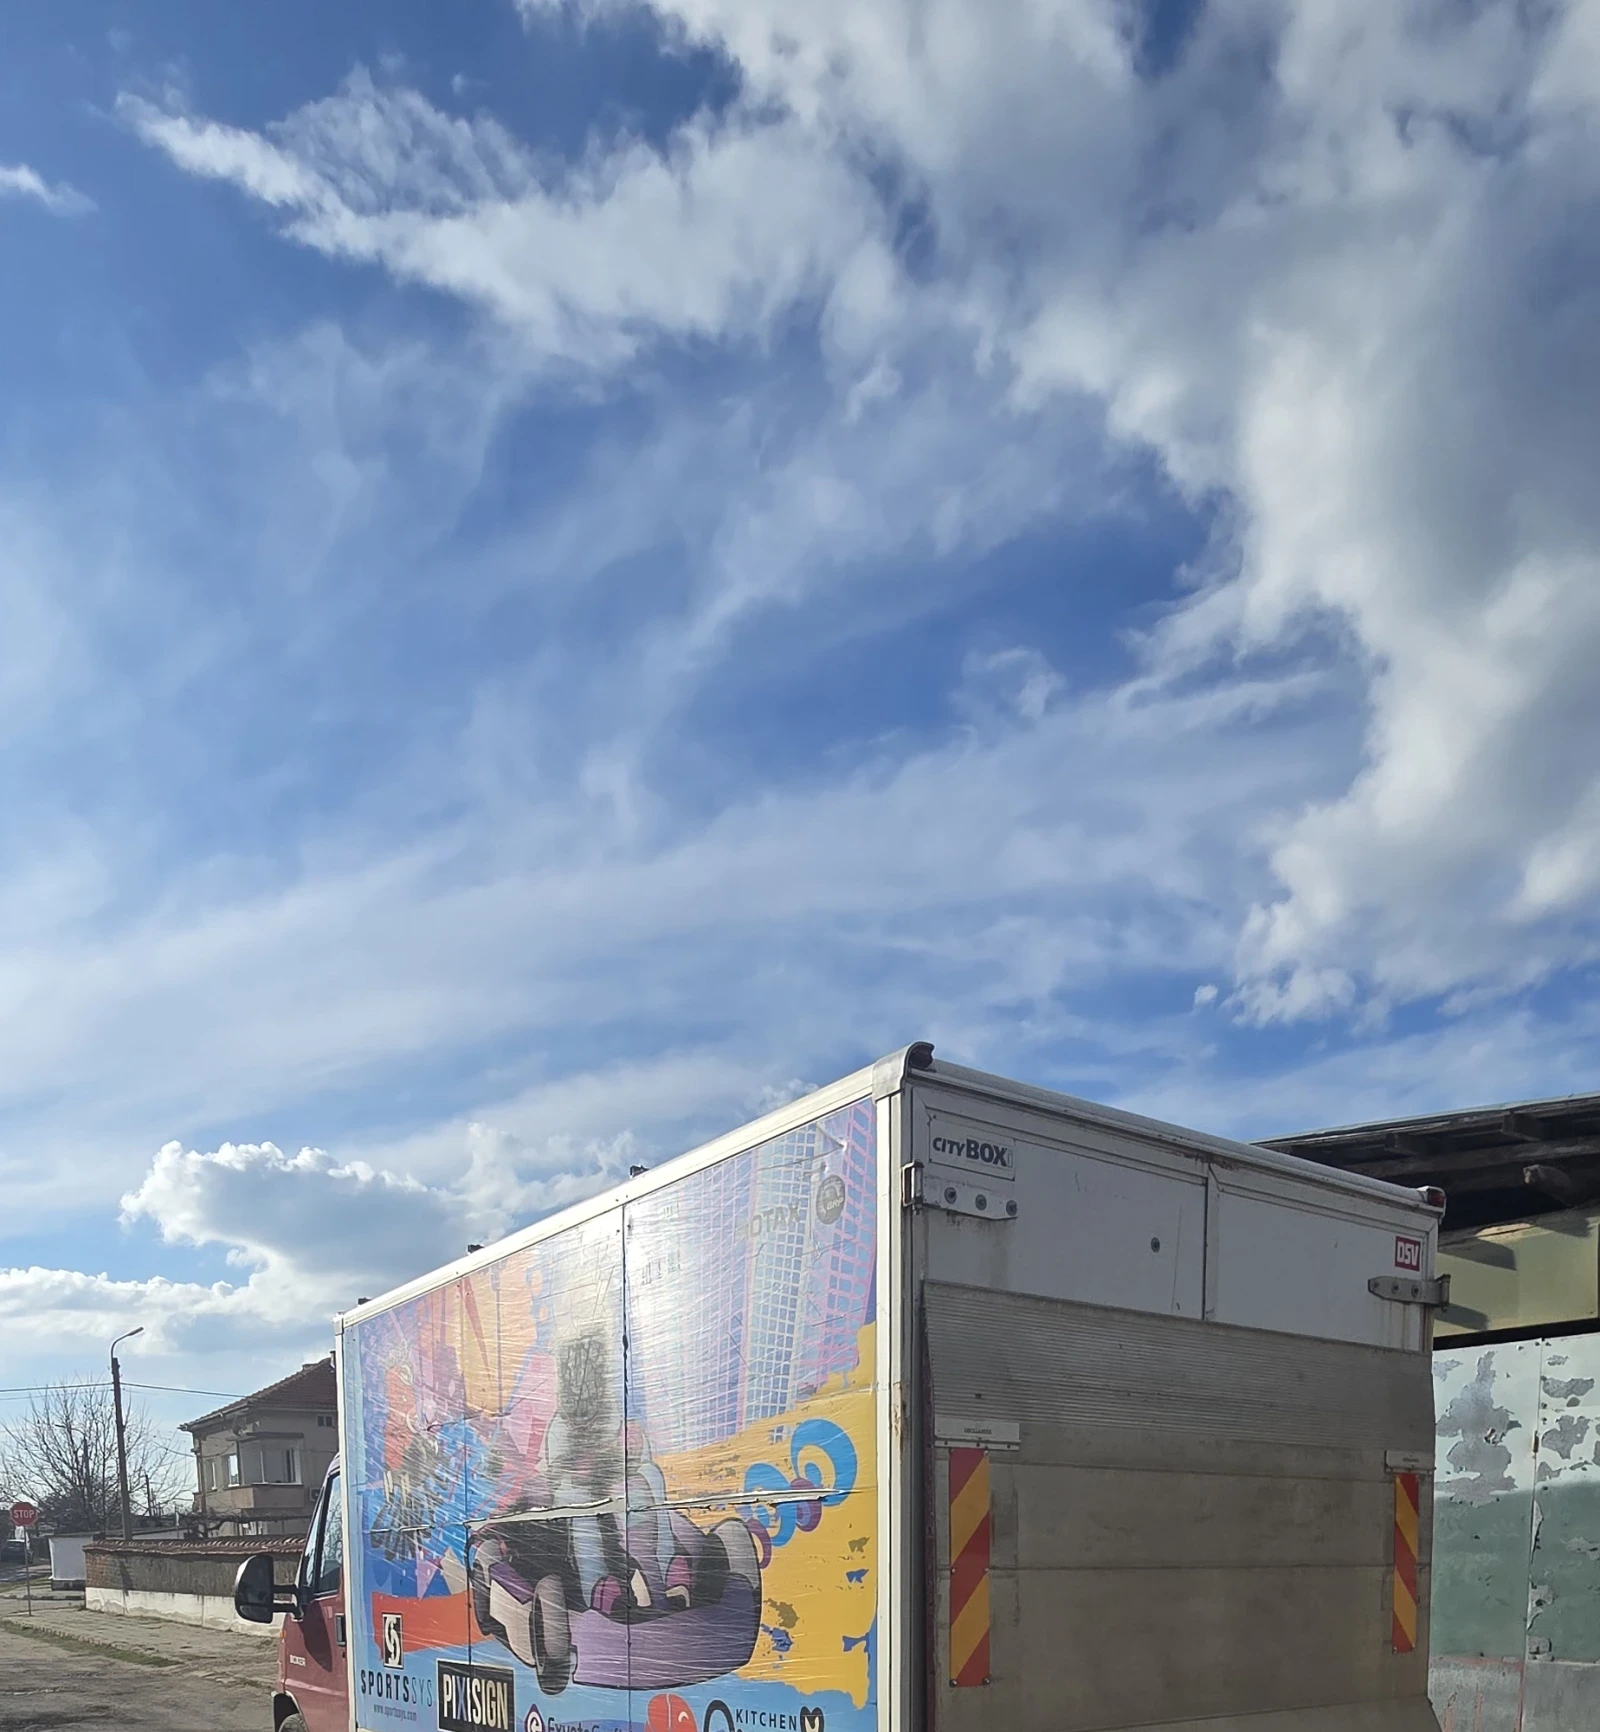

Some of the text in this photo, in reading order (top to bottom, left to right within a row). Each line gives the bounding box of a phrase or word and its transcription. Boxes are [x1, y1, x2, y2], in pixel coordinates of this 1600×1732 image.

[932, 1137, 1008, 1167] CITYBOX
[1397, 1241, 1419, 1266] DSV
[13, 1509, 35, 1519] STOP
[361, 1669, 433, 1707] SPORTSSYS
[442, 1674, 509, 1730] PIXISIGN
[736, 1708, 798, 1731] KITCHEN
